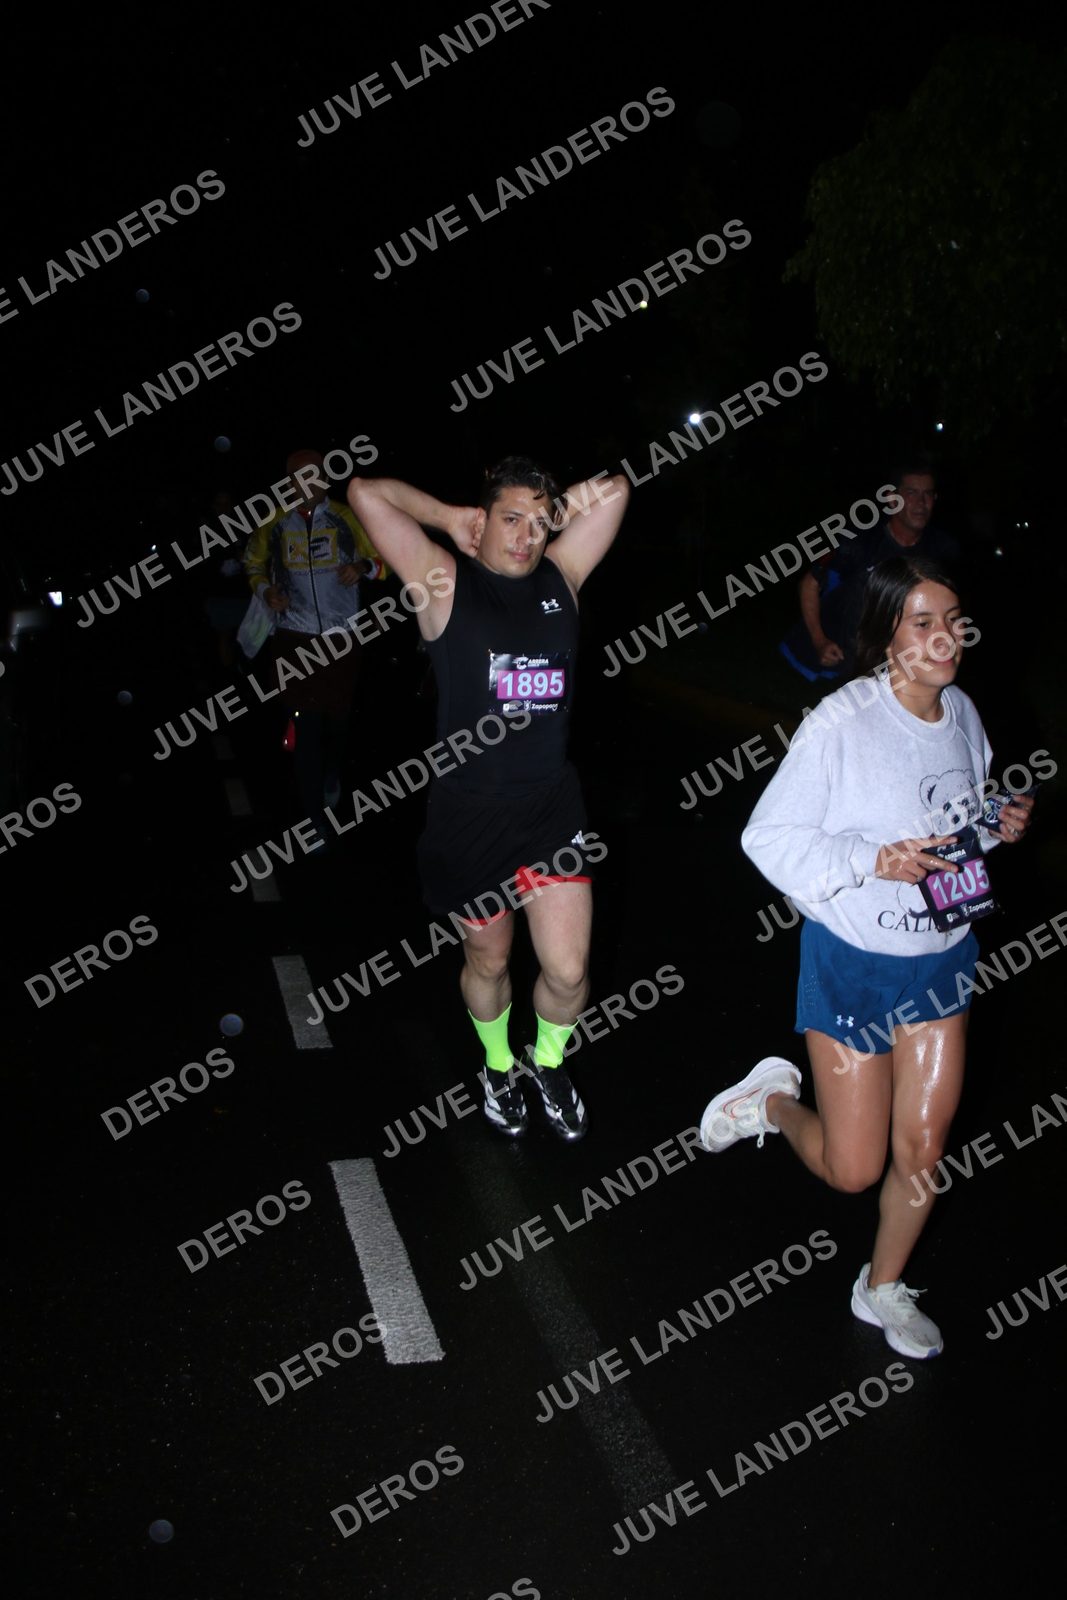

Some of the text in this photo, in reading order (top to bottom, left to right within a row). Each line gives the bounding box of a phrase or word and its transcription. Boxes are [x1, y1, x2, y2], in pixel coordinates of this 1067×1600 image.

[502, 671, 564, 697] 1895
[932, 860, 990, 905] 1205
[877, 910, 938, 932] CALI
